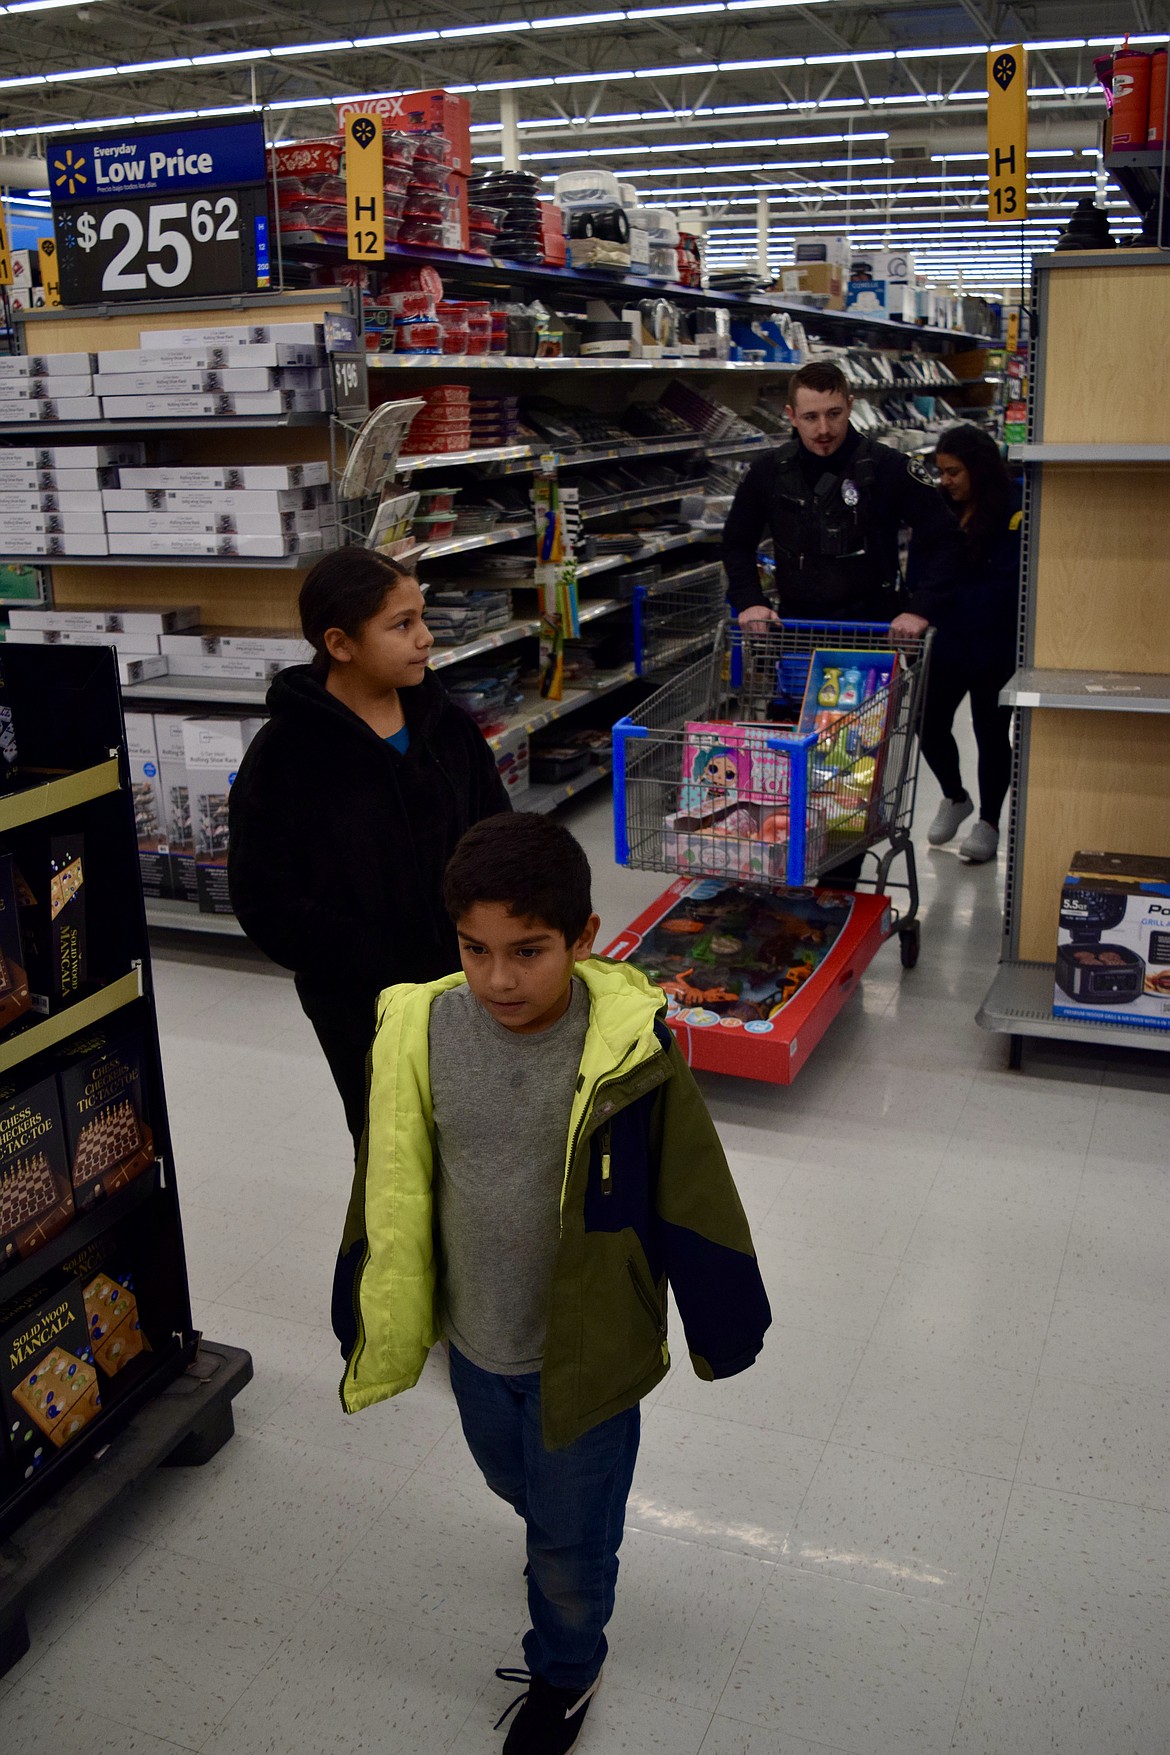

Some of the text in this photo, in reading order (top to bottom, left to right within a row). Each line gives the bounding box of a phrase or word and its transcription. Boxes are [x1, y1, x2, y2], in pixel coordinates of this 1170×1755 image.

[339, 97, 405, 129] pyrex
[93, 143, 137, 158] Everyday
[995, 145, 1015, 176] H
[94, 148, 213, 185] Low Price
[355, 196, 376, 221] H
[994, 186, 1016, 214] 13
[355, 231, 378, 254] 12
[1141, 918, 1164, 926] GRILL
[60, 924, 72, 999] MANCALA
[84, 1063, 130, 1096] CHECKERS
[92, 1058, 120, 1080] CHESS
[0, 1106, 32, 1132] CHESS
[0, 1112, 42, 1144] HECKERS
[9, 1310, 76, 1370] MANCALA
[12, 1323, 40, 1352] SOLID
[41, 1301, 69, 1327] WOOD
